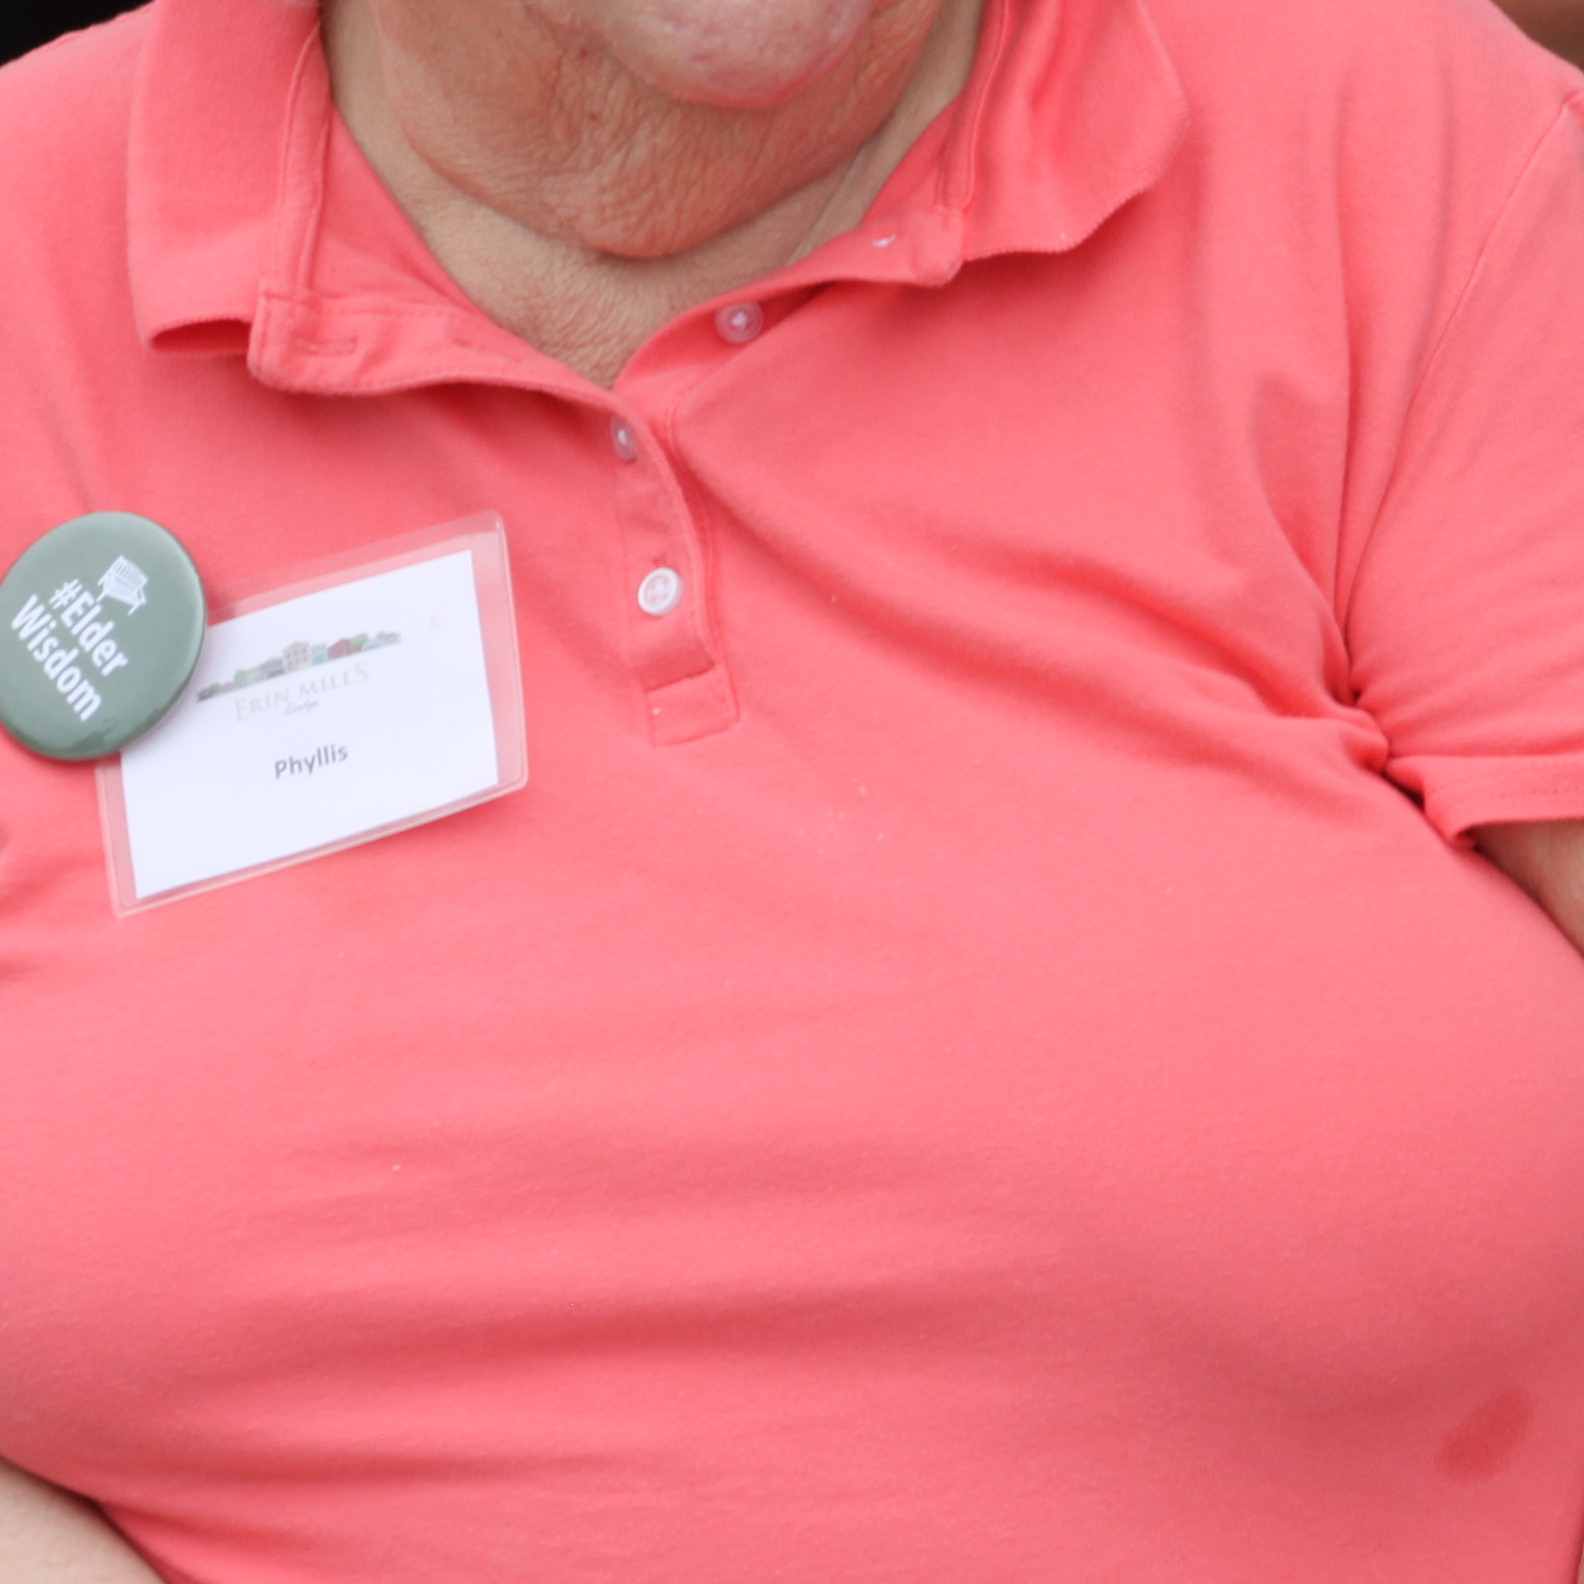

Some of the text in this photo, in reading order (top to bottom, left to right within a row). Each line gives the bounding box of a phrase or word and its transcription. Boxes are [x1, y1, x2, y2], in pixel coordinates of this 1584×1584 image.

[11, 593, 101, 722] Wisdom
[49, 578, 128, 677] #Elder
[235, 660, 369, 722] ERIN MILLS
[274, 743, 349, 780] Phyllis
